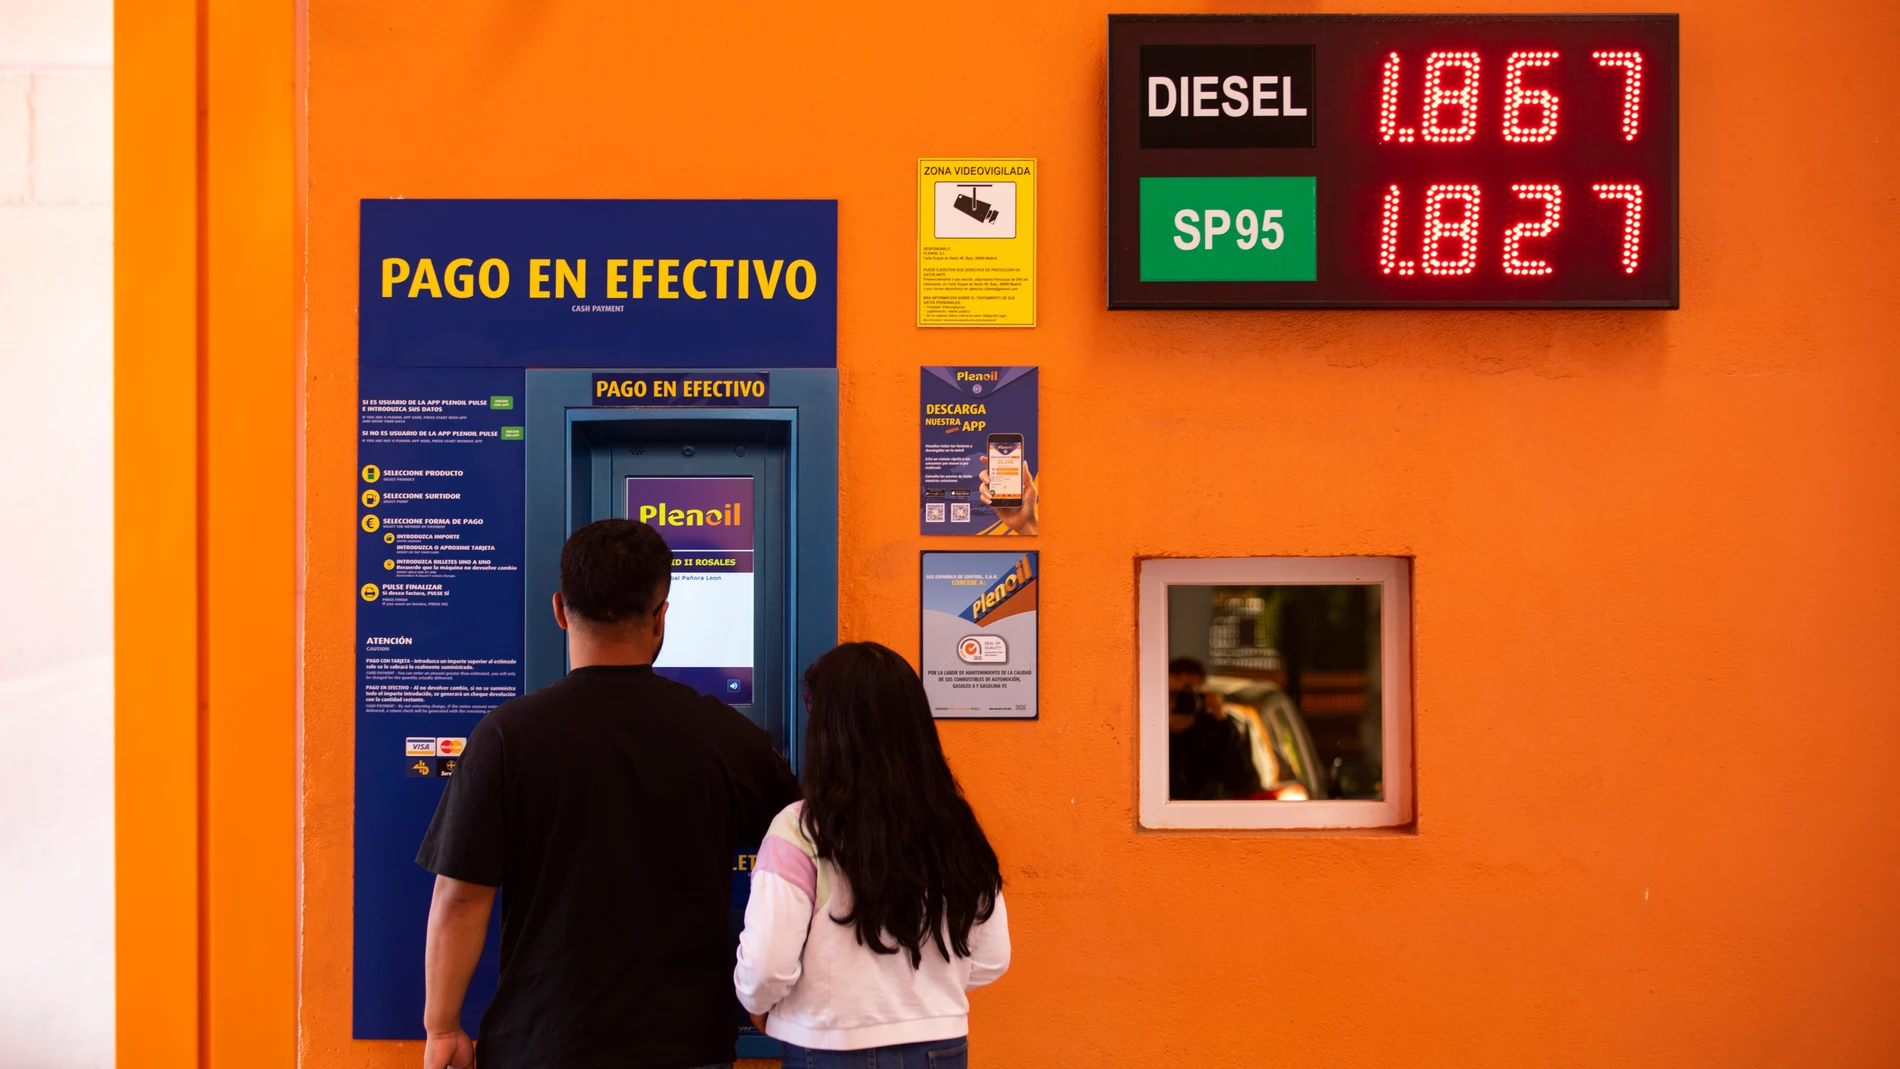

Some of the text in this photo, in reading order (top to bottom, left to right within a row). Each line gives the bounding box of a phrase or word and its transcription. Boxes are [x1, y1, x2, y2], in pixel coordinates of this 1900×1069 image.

[1148, 75, 1307, 118] DIESEL
[924, 167, 1030, 175] ZONA VIDEOVIGILADA
[1173, 209, 1284, 251] SP95
[381, 257, 817, 300] PAGO EN EFECTIVO
[572, 304, 624, 313] CASH PAYMENT
[957, 371, 998, 381] Plenoil
[596, 380, 765, 398] PAGO EN EFECTIVO
[926, 404, 986, 414] DESCARGA
[962, 421, 986, 431] APP
[640, 503, 740, 526] Plenoil
[973, 556, 1032, 619] Plenoil
